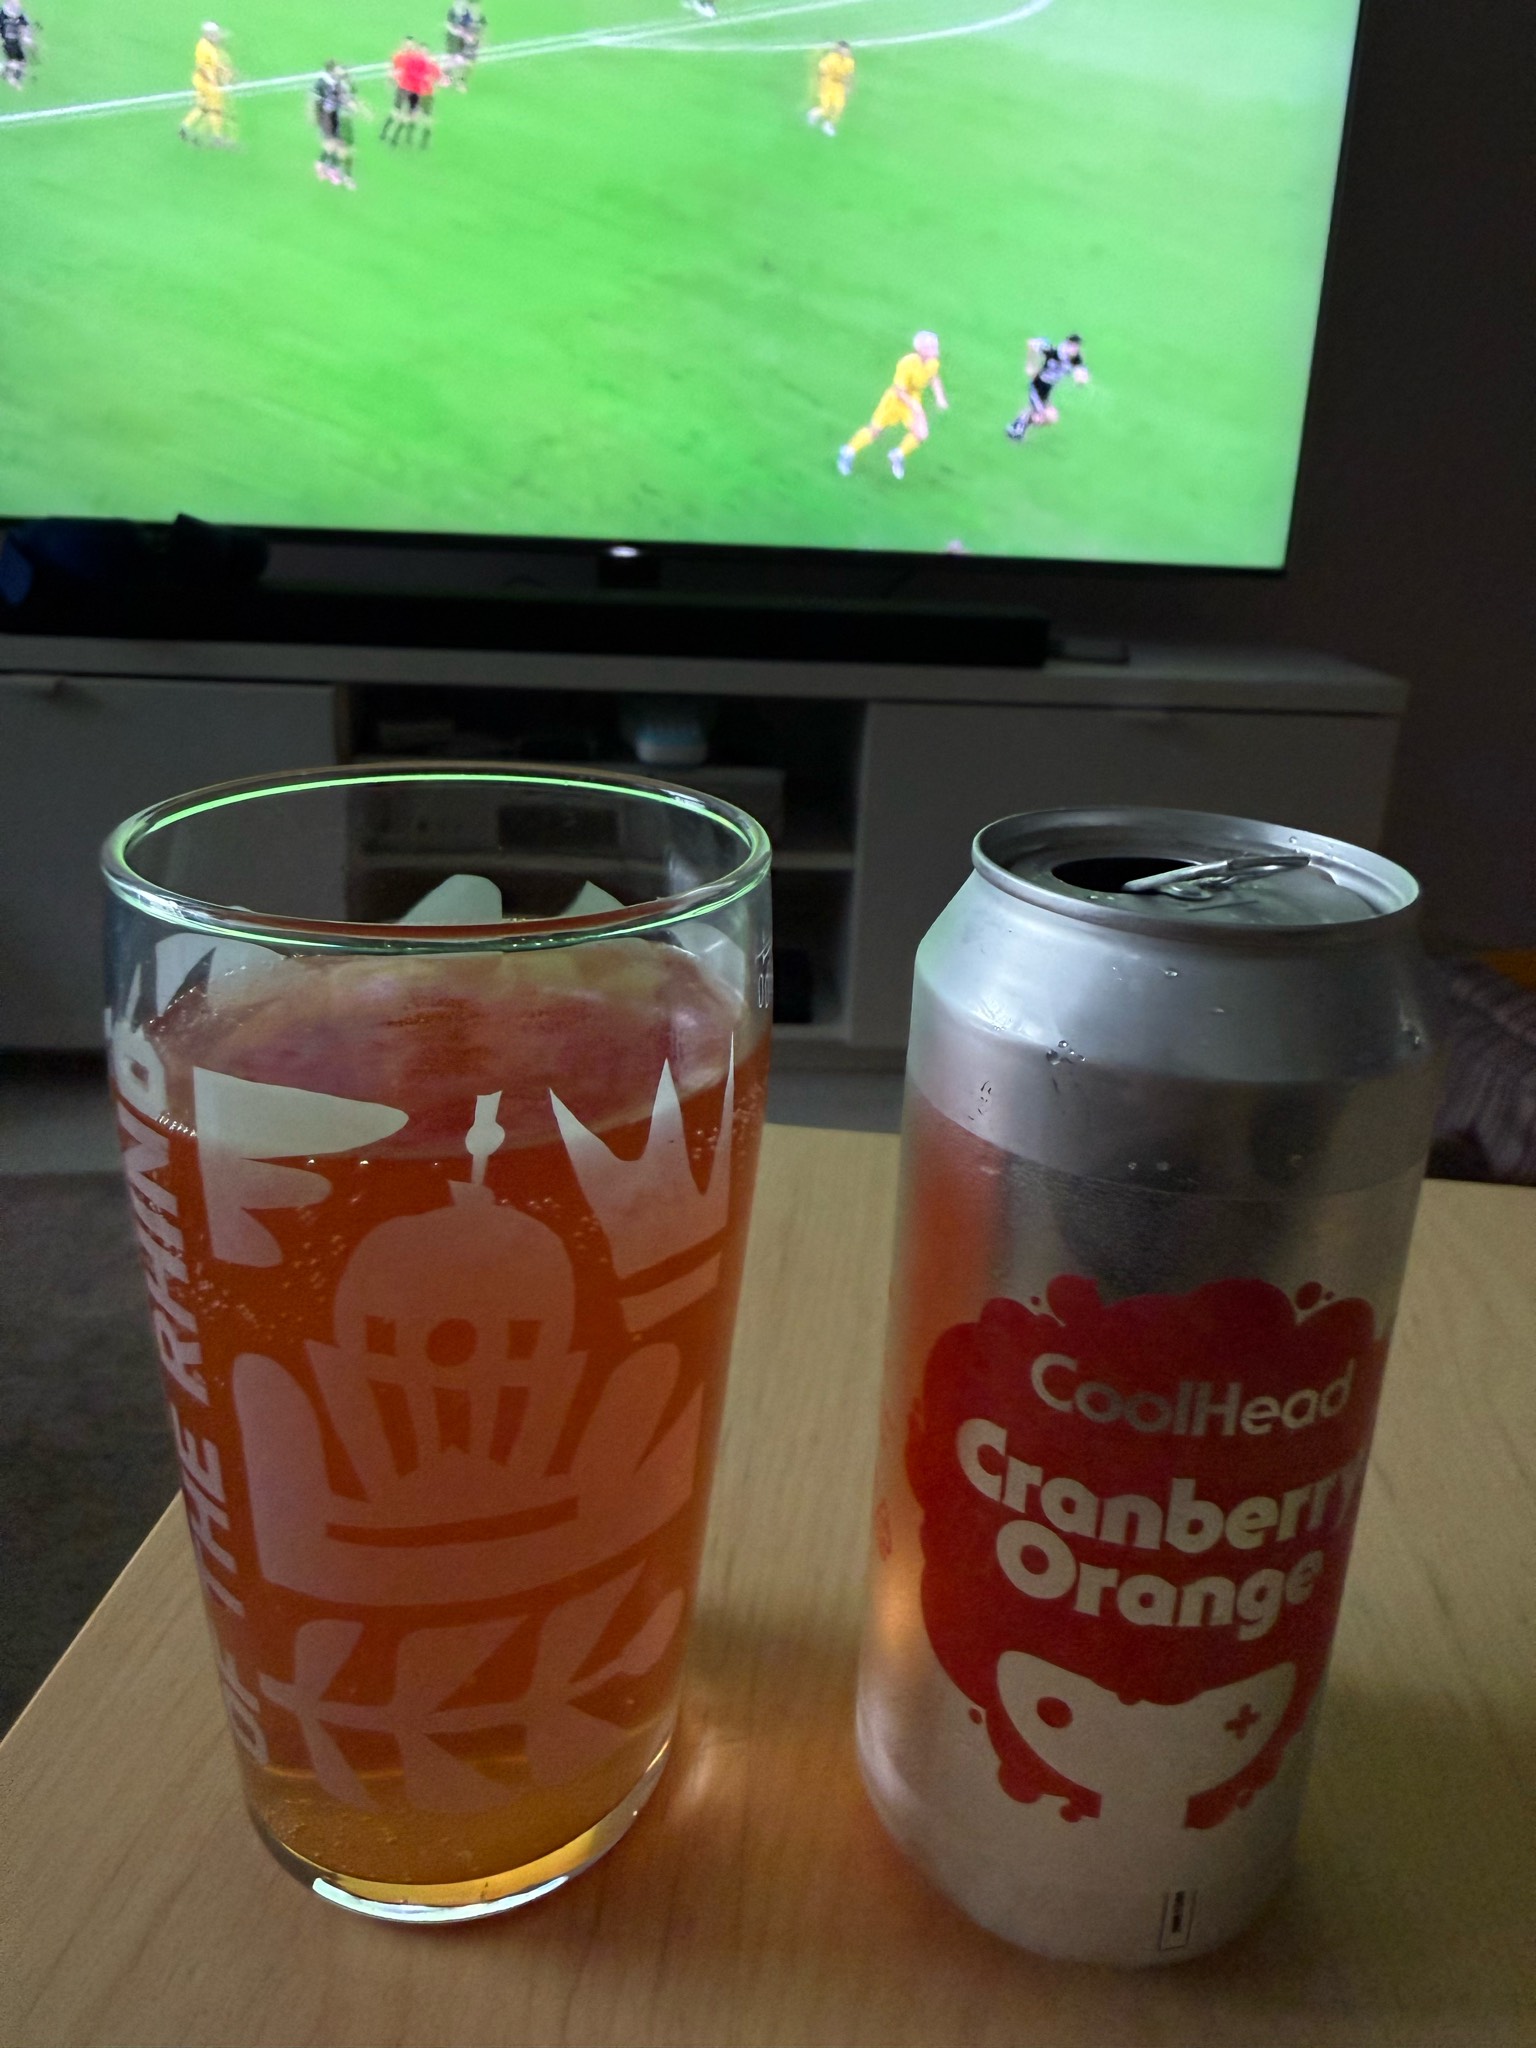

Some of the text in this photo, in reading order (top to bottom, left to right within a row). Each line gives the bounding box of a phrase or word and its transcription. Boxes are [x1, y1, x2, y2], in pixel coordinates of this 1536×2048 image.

[1031, 1353, 1355, 1436] CoolHead
[171, 1403, 245, 1617] THE
[996, 1519, 1323, 1641] Orange
